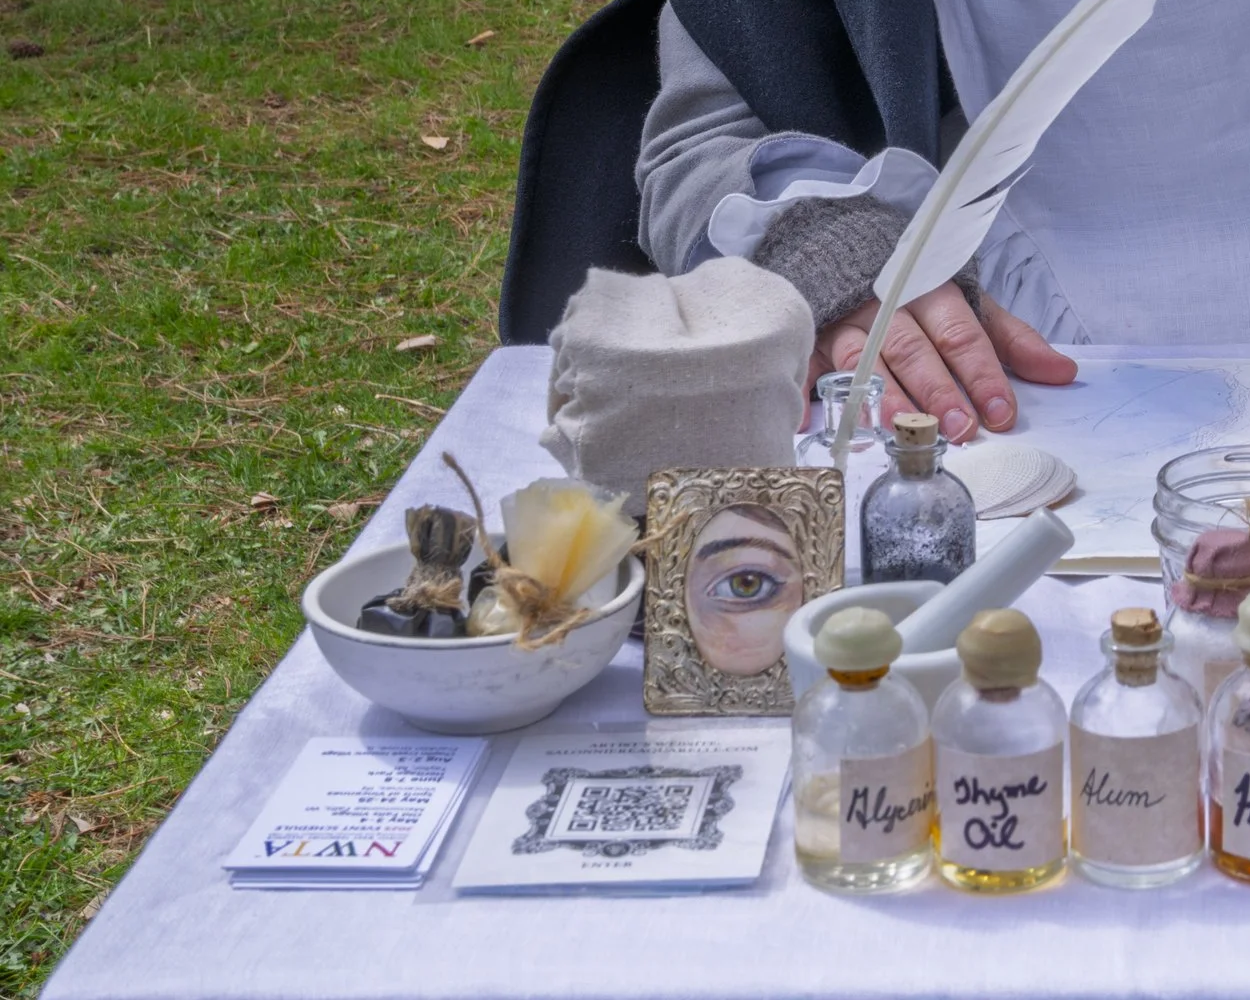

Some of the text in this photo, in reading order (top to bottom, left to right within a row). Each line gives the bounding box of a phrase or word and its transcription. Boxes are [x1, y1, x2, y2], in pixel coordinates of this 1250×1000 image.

[400, 796, 430, 804] May
[954, 774, 1047, 820] Thyme
[1080, 767, 1166, 808] Alum
[964, 815, 1024, 850] Oil
[264, 840, 403, 857] NWTA
[581, 861, 632, 869] ENTER
